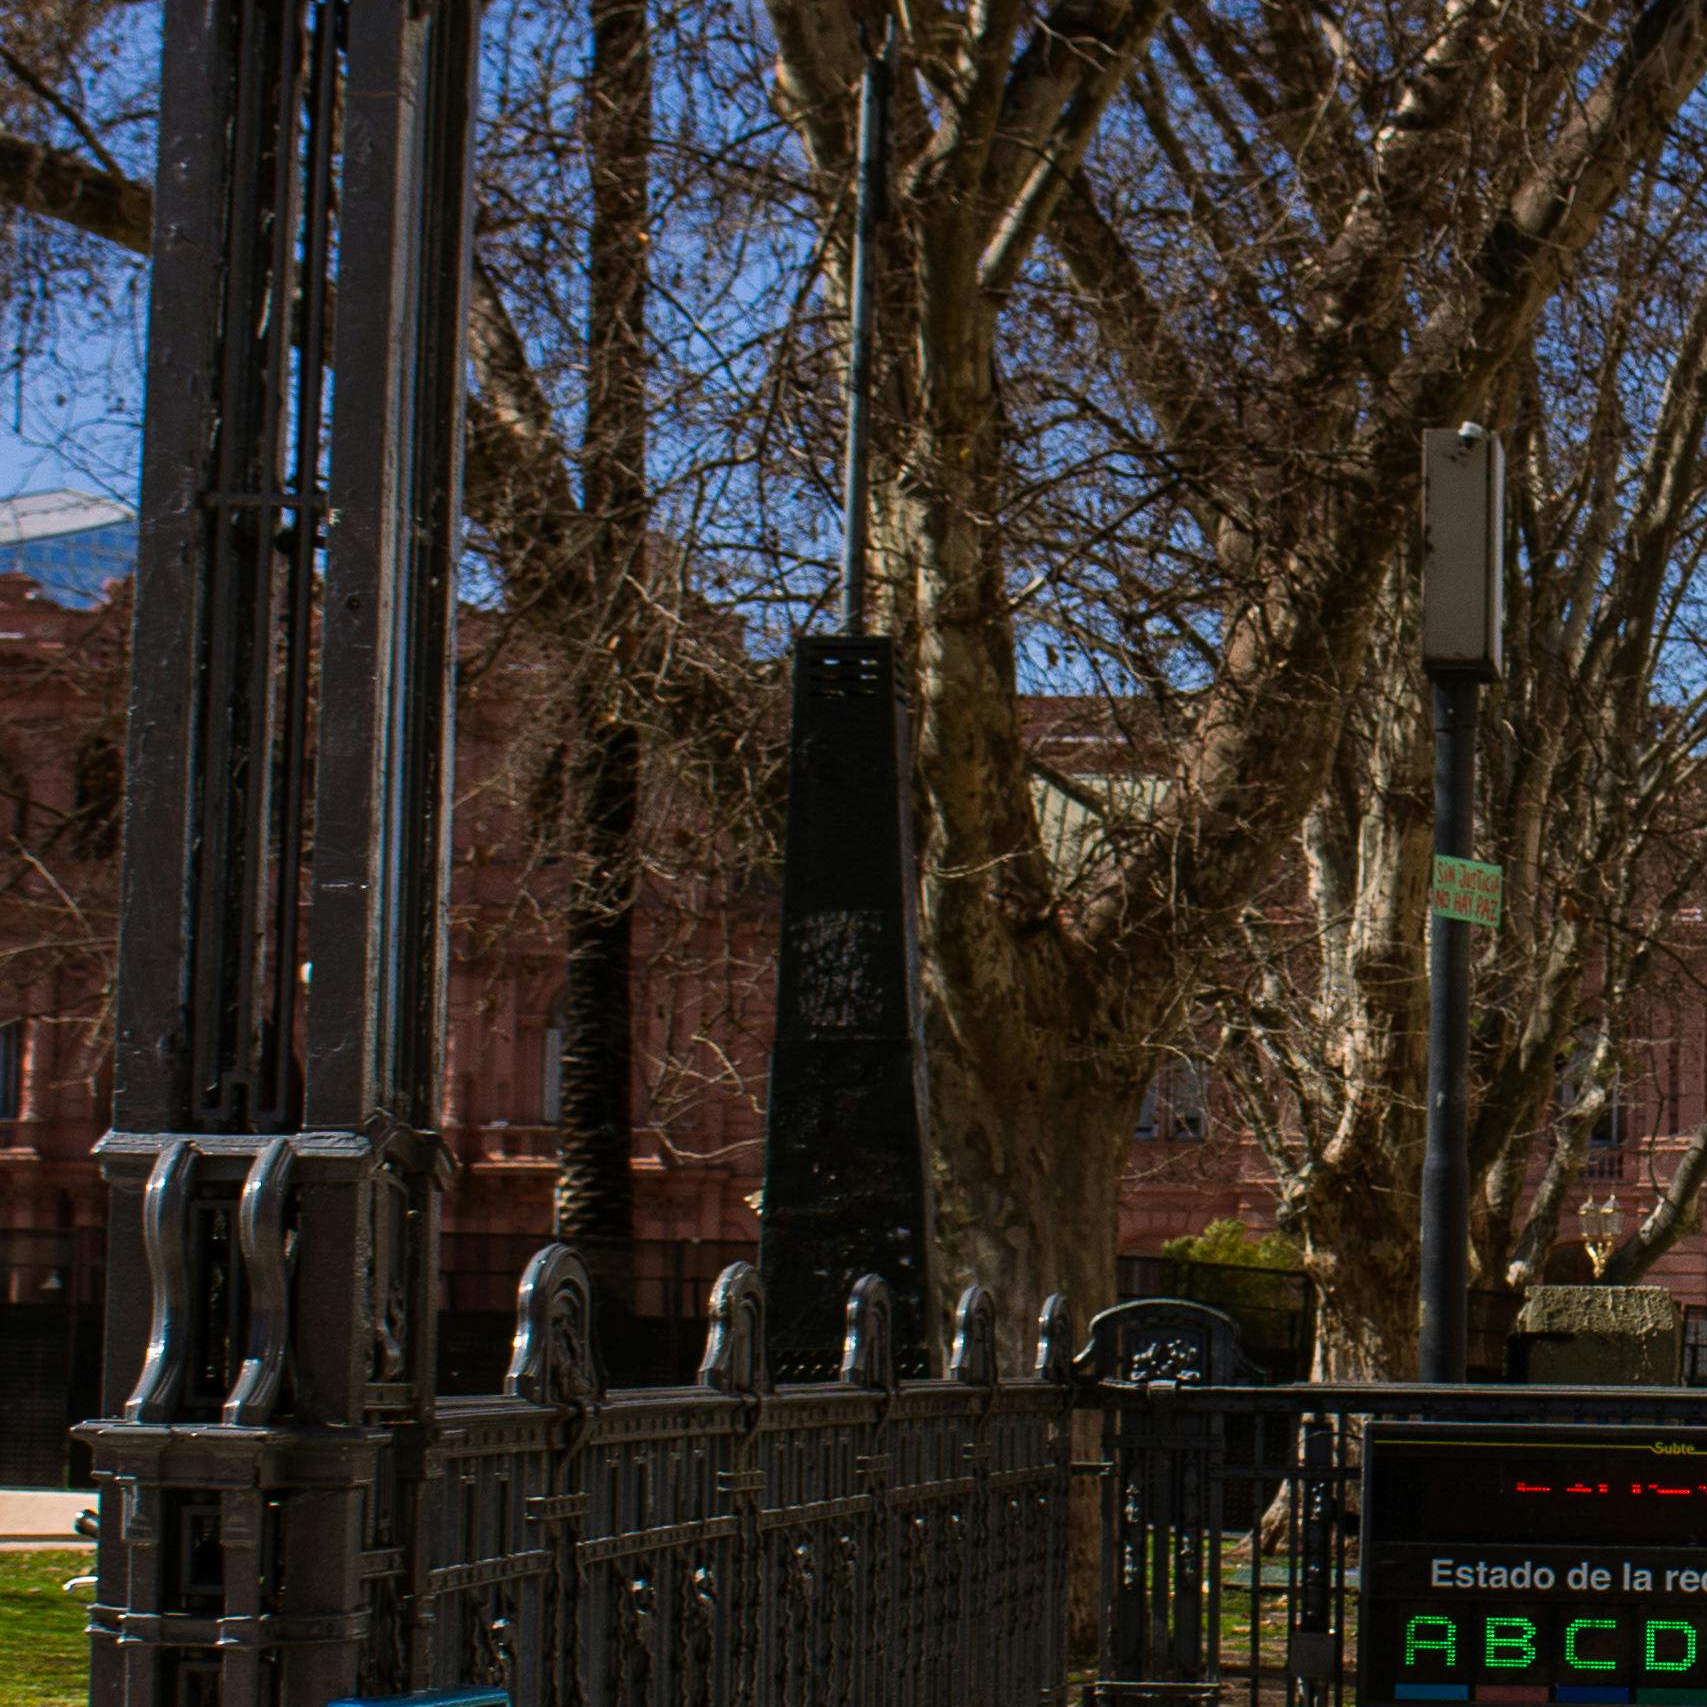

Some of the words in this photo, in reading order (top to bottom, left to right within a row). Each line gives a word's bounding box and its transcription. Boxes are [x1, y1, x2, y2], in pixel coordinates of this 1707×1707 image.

[1653, 1441, 1696, 1455] Subte
[1431, 1558, 1556, 1590] Estado
[1567, 1560, 1612, 1591] de
[1623, 1561, 1653, 1592] la
[1405, 1615, 1457, 1667] A
[1485, 1617, 1537, 1668] B
[1565, 1619, 1617, 1670] C
[1645, 1620, 1697, 1671] D
